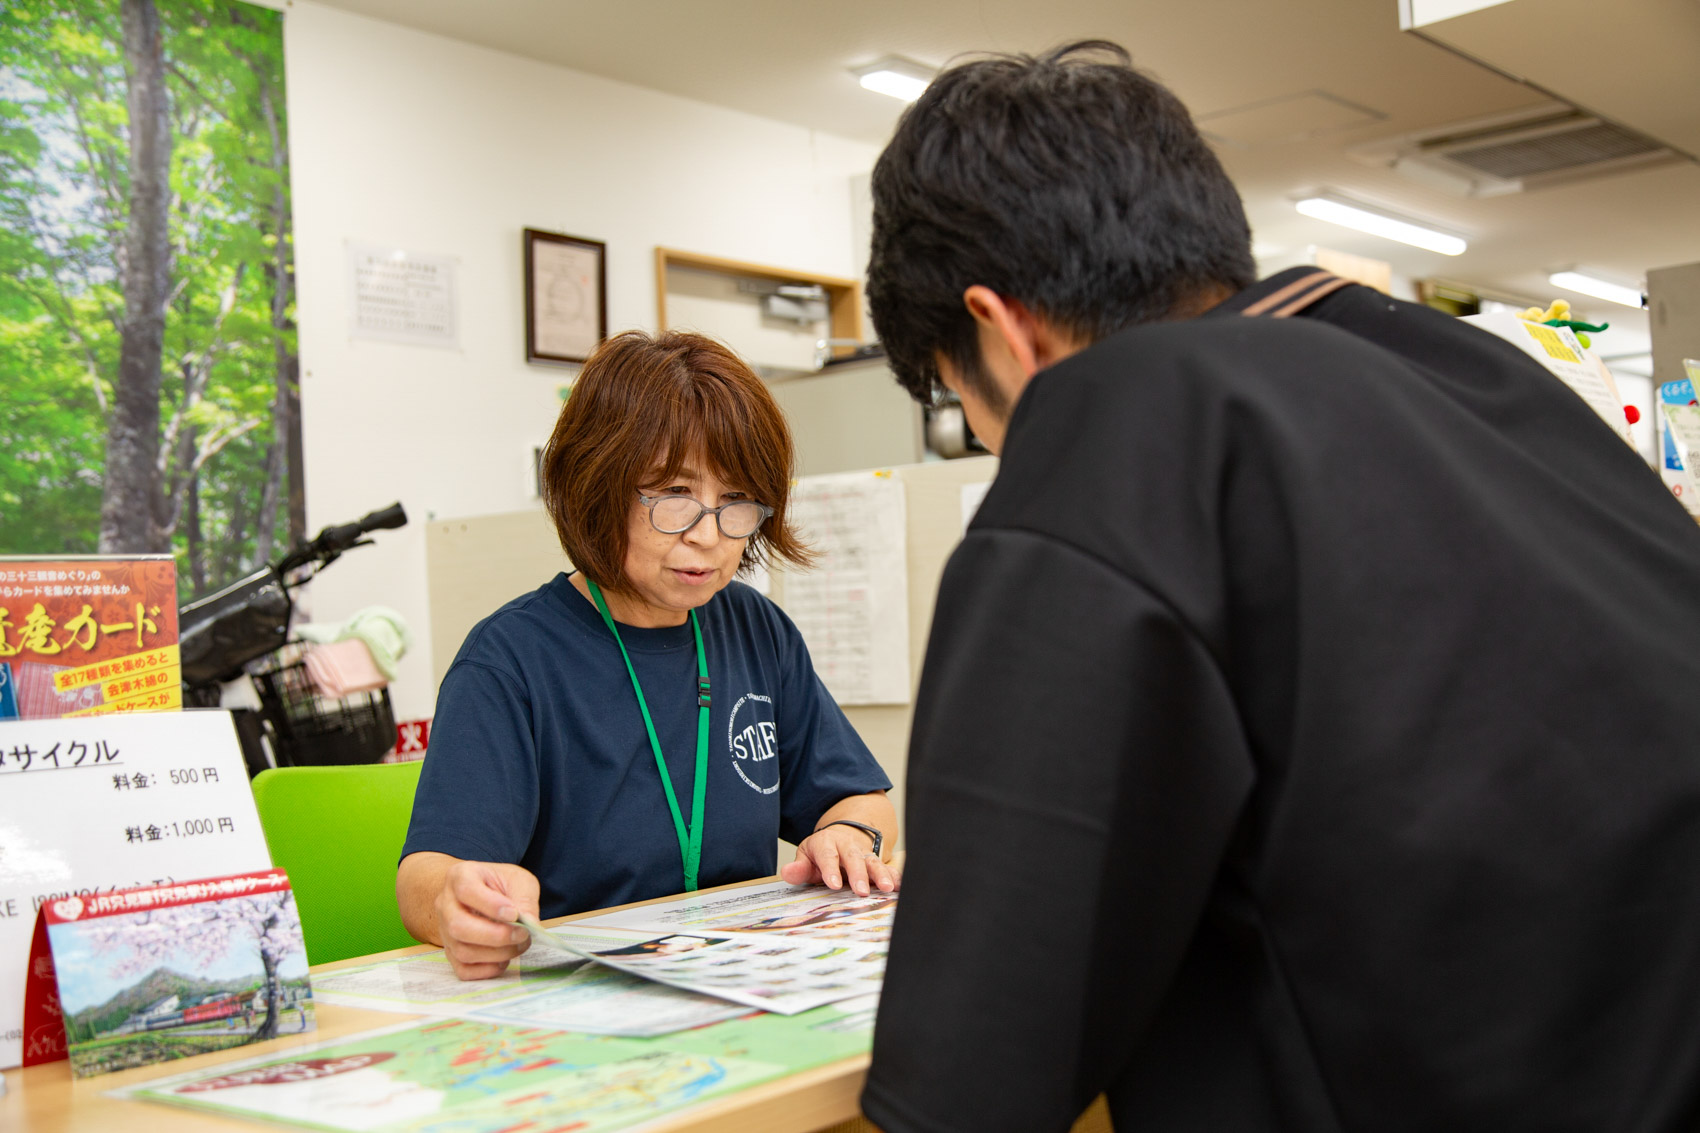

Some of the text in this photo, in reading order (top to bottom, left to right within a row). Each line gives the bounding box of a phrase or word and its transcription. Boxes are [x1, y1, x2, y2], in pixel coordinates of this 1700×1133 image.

[0, 584, 131, 597] らカードを集めてみませんか
[60, 652, 169, 688] 全17種類を集めると
[107, 672, 169, 698] 会津木綿の
[0, 739, 120, 771] サイクル
